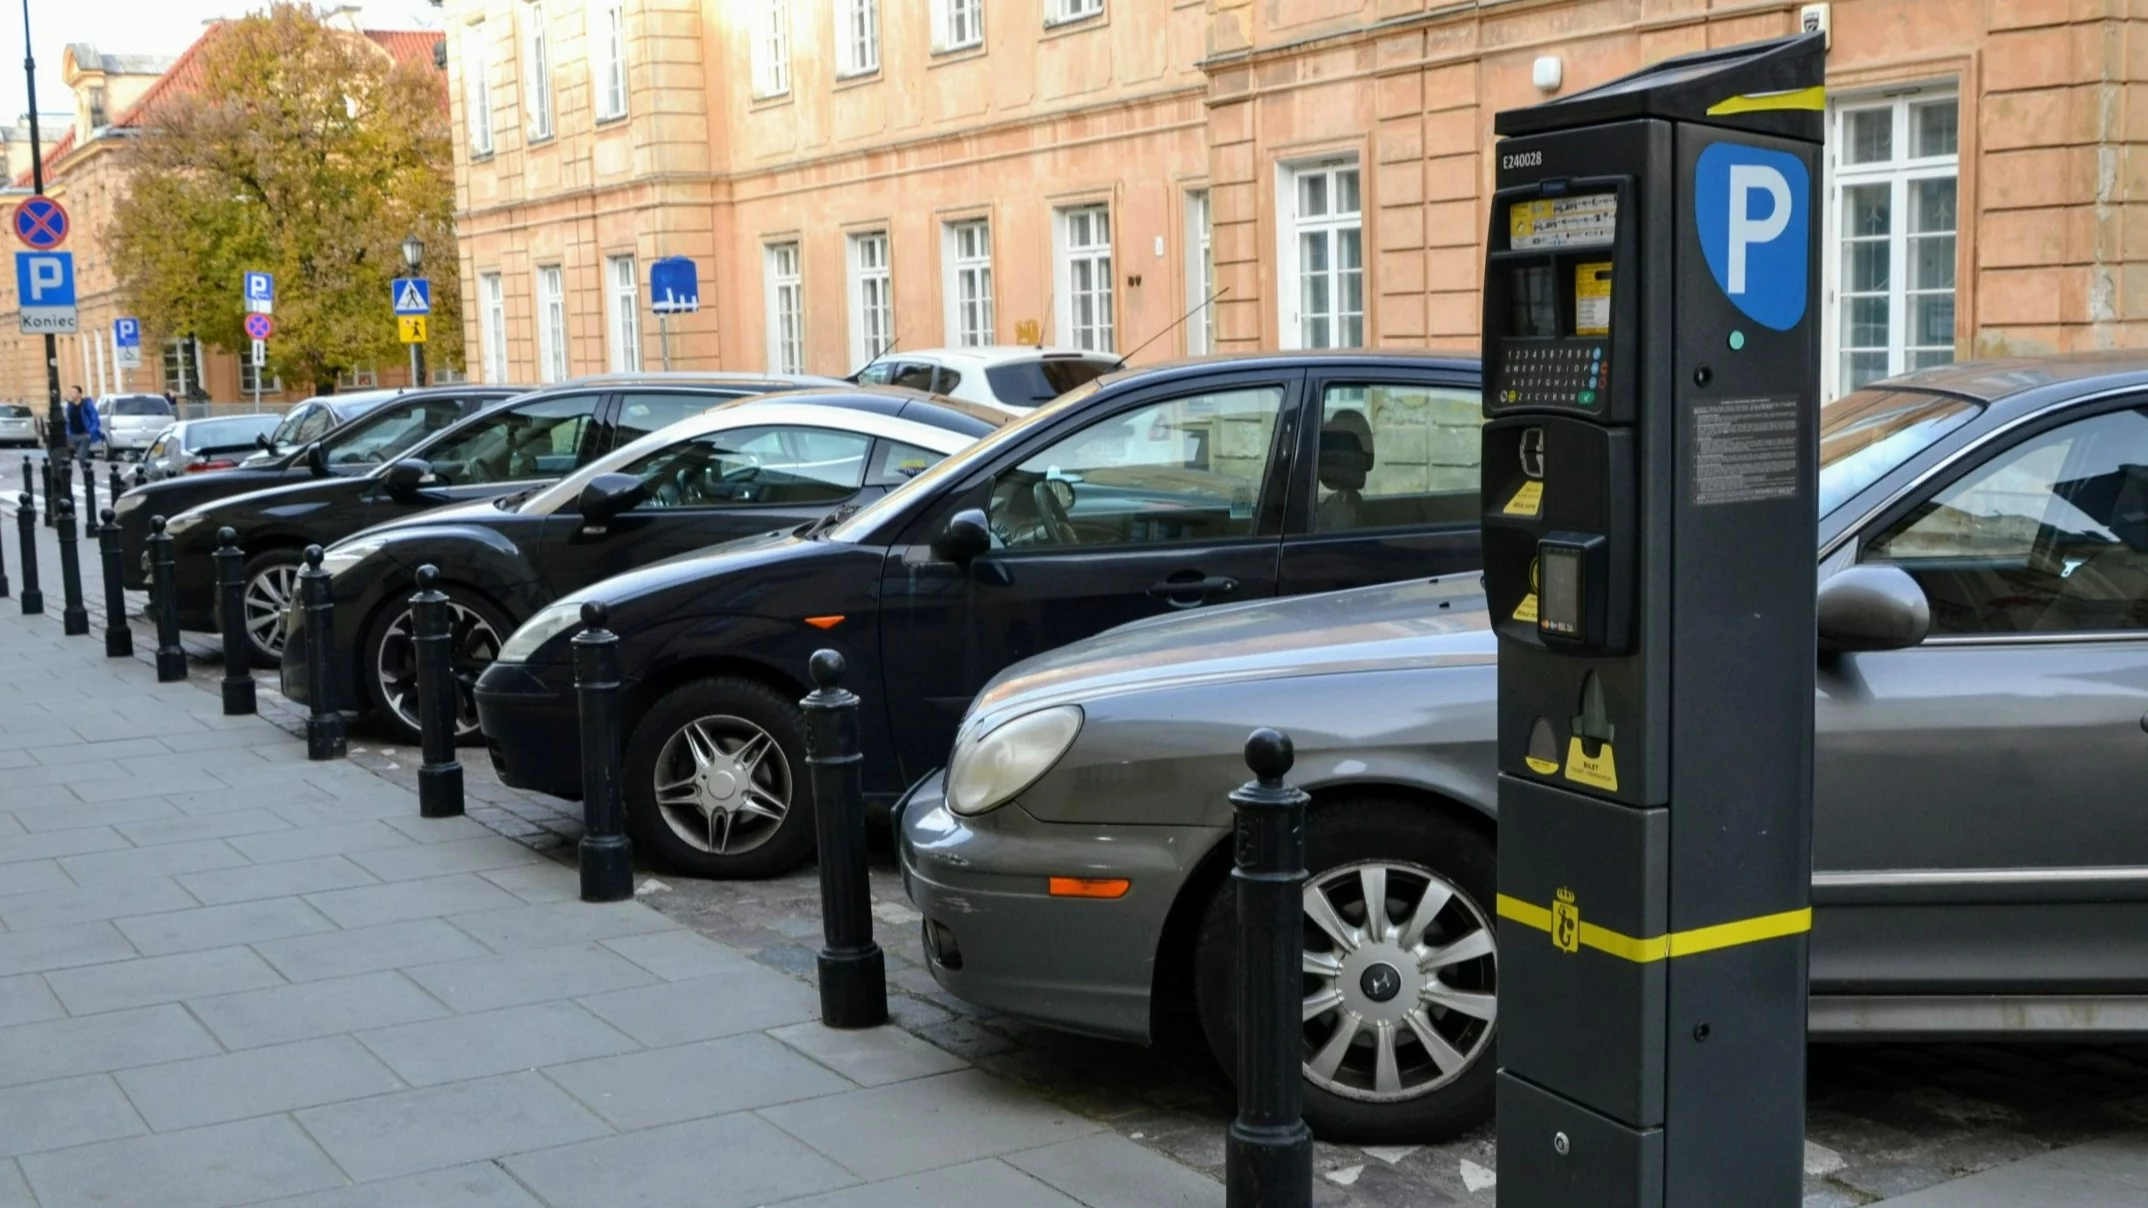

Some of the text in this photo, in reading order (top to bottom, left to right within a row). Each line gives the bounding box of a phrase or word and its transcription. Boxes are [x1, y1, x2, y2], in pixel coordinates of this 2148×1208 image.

[1503, 151, 1542, 169] E240028
[1728, 164, 1792, 294] P
[28, 257, 64, 300] P
[250, 274, 267, 297] P
[22, 314, 76, 328] Koniec
[119, 320, 134, 339] P
